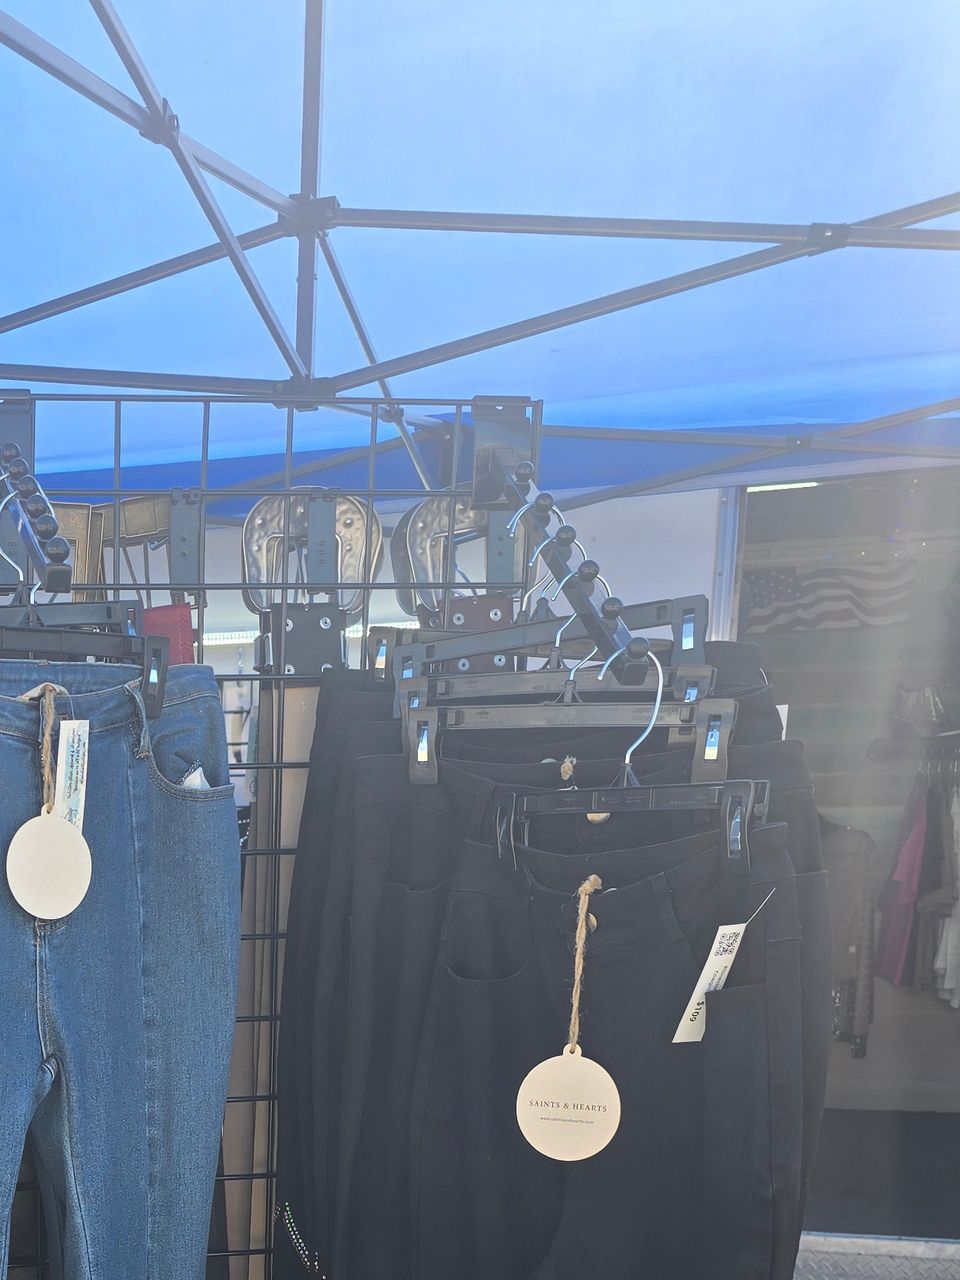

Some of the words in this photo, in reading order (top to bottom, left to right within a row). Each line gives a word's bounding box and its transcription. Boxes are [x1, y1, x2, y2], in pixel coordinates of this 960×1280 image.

[689, 1000, 705, 1023] $109
[528, 1099, 561, 1109] SAINTS
[563, 1102, 570, 1110] &
[572, 1103, 608, 1113] HEARTS
